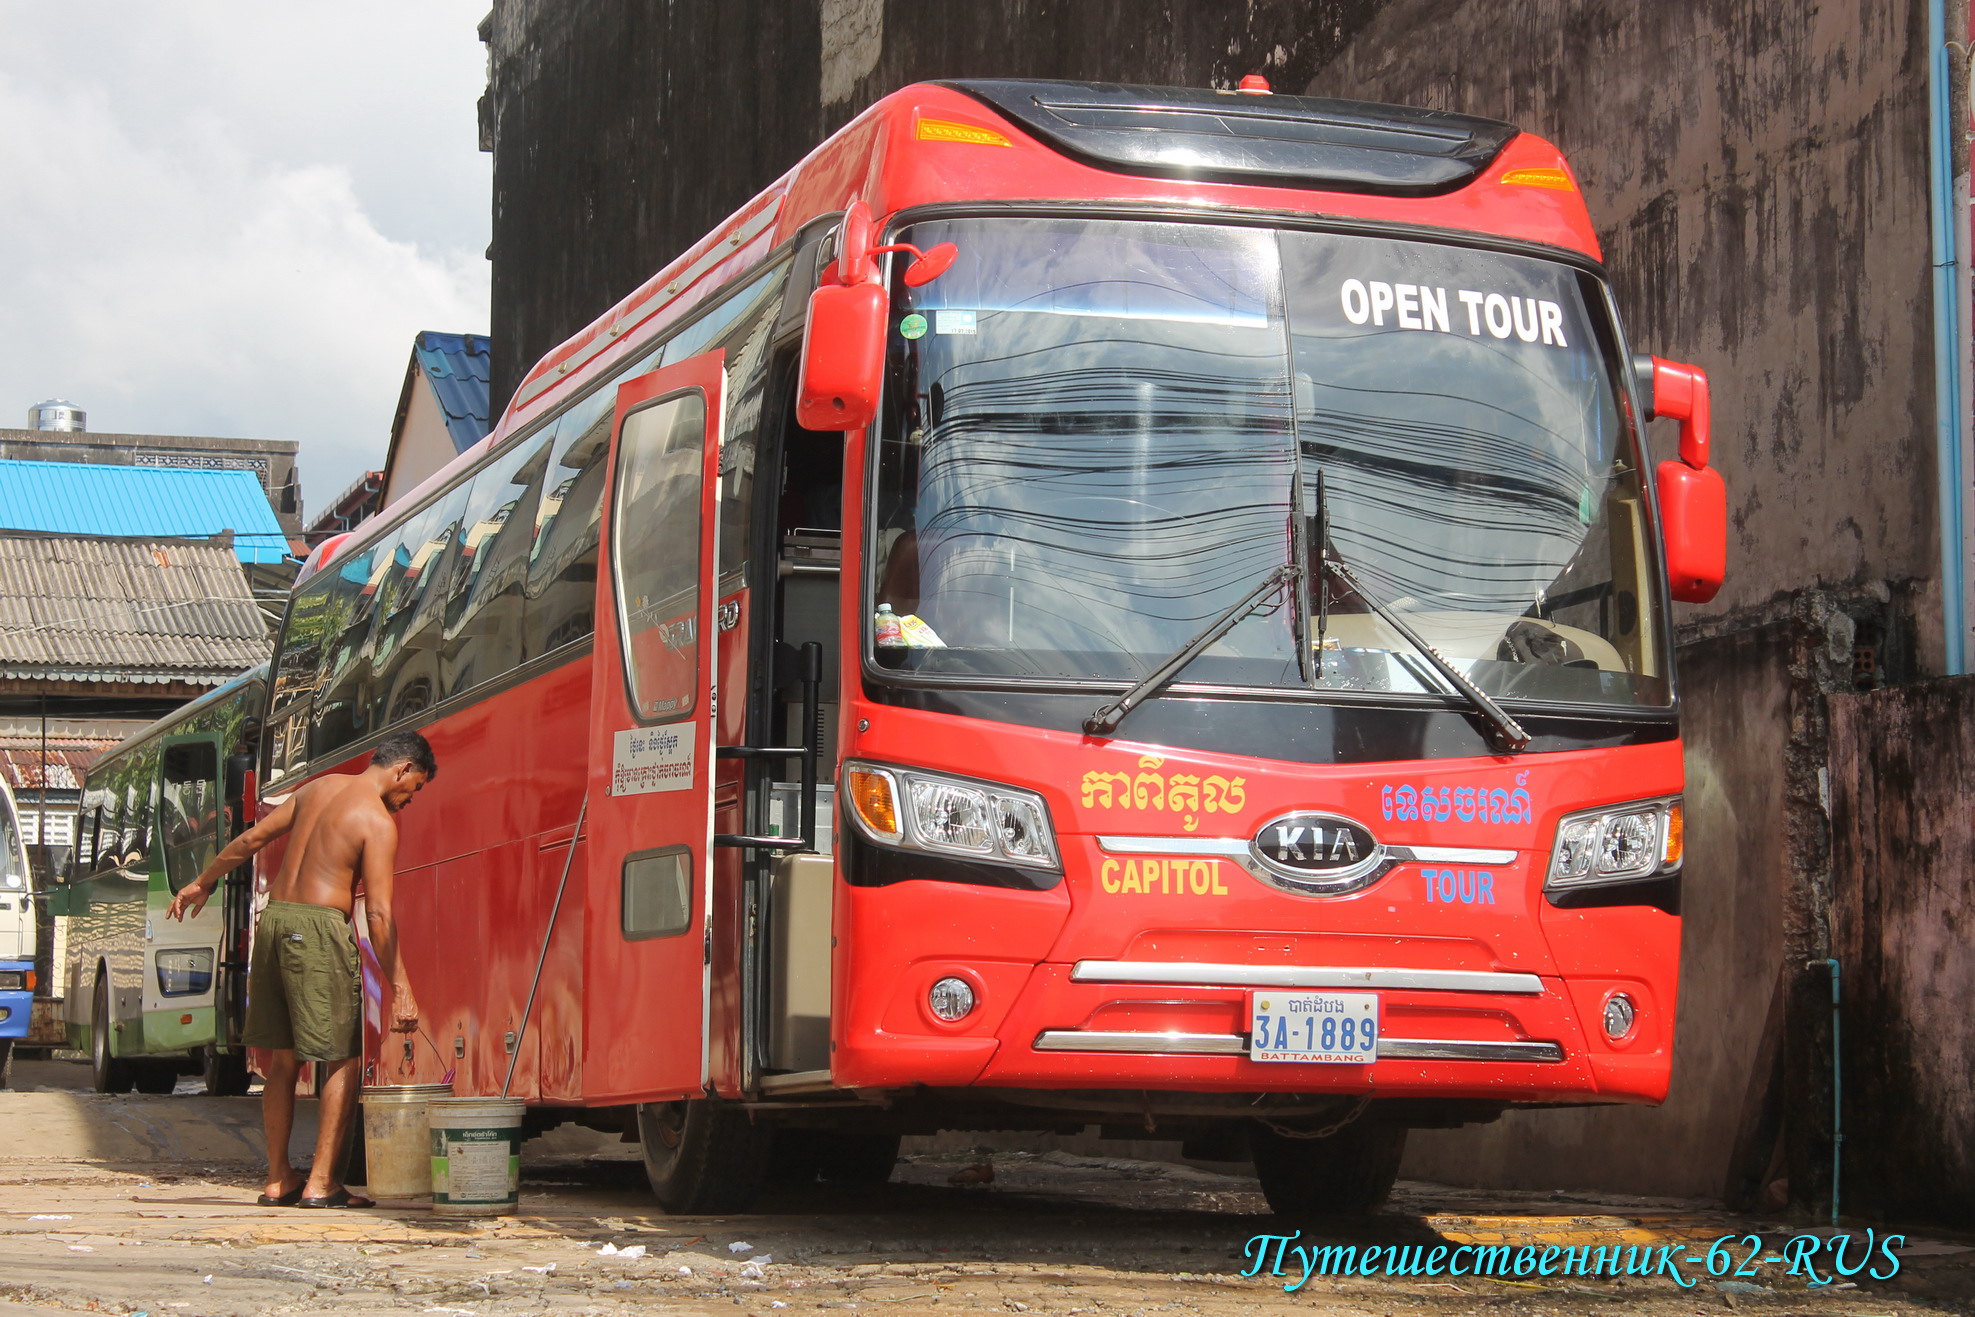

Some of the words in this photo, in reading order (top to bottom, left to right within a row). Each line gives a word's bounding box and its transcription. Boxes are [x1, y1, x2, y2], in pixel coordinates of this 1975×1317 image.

[1340, 278, 1451, 332] OPEN
[1458, 289, 1568, 348] TOUR
[1381, 769, 1532, 824] ទេសចរណ៍
[1276, 826, 1359, 861] KIA
[1101, 859, 1229, 895] CAPITOL
[1421, 869, 1495, 904] TOUR
[1288, 995, 1345, 1013] បាត់ដំបង
[1255, 1015, 1375, 1051] 3A-1889
[1261, 1052, 1365, 1062] BATTAMBANG
